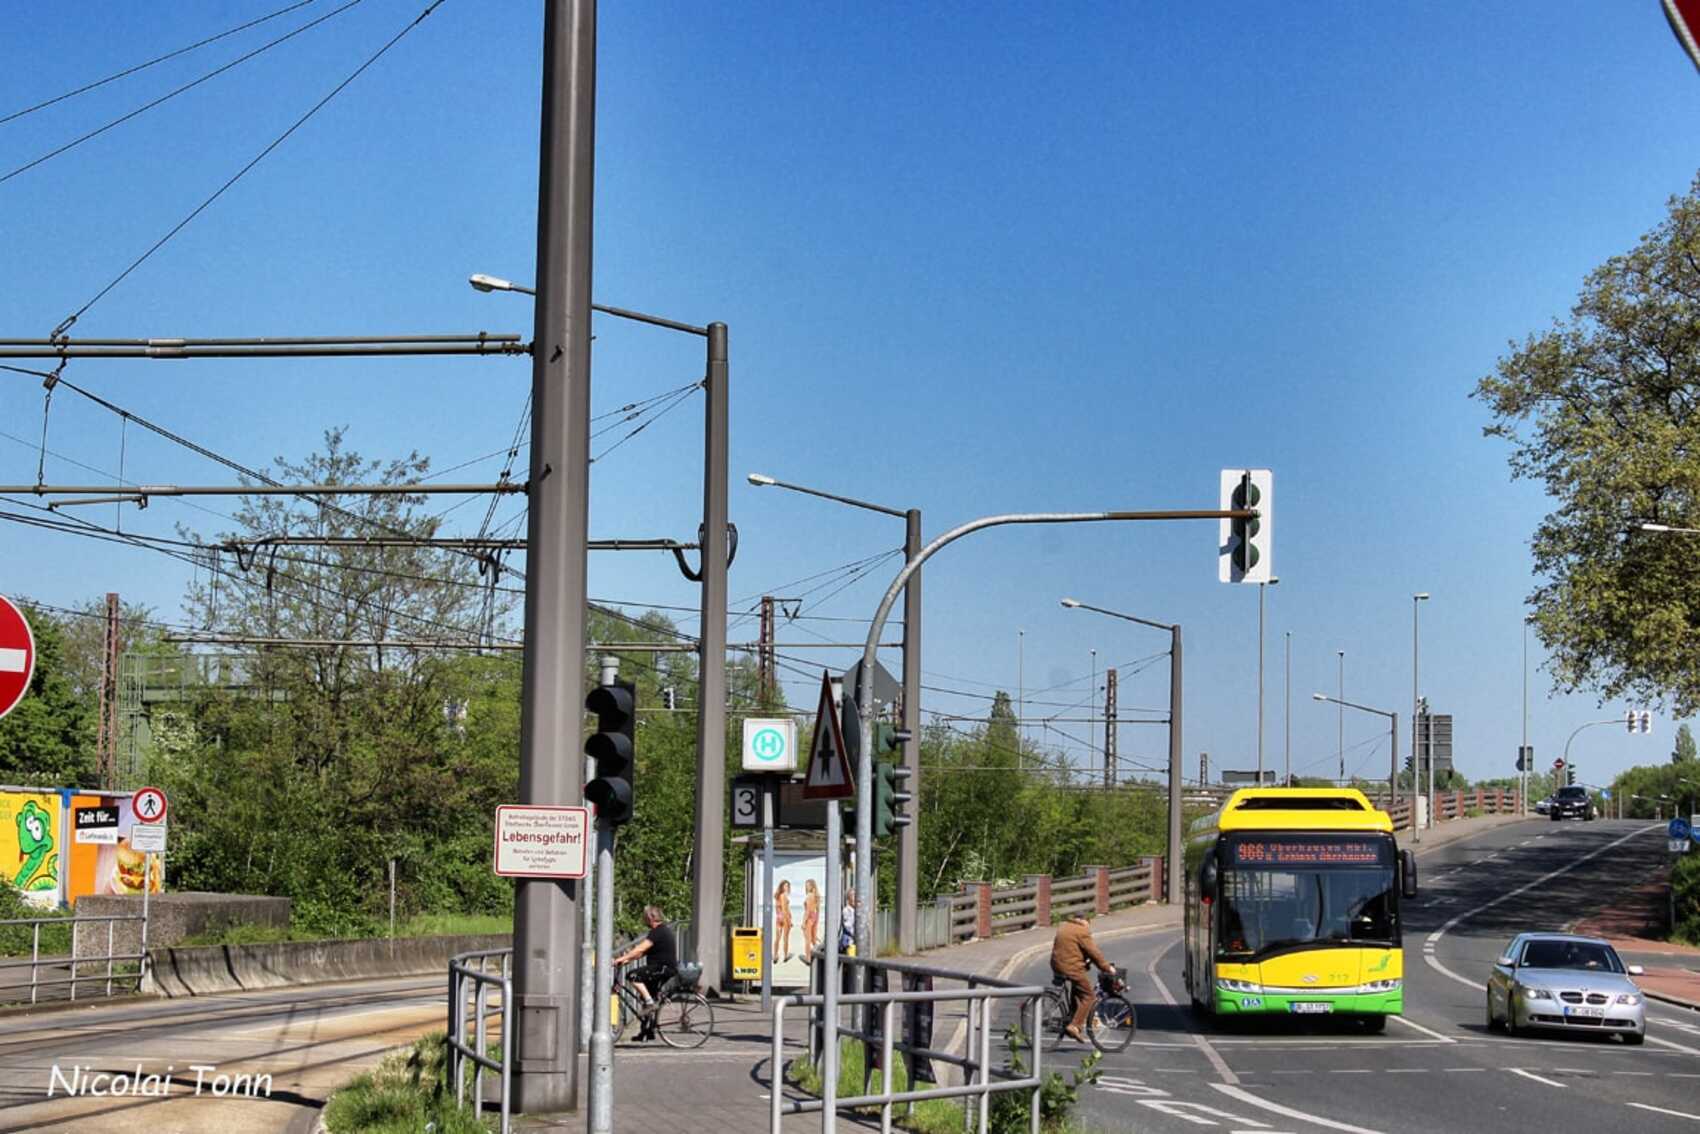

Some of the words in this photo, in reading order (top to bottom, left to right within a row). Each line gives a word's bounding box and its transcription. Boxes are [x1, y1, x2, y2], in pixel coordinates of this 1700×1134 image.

[737, 789, 756, 817] 3
[79, 811, 95, 824] Zeit
[503, 831, 581, 845] Lebensgefahr!
